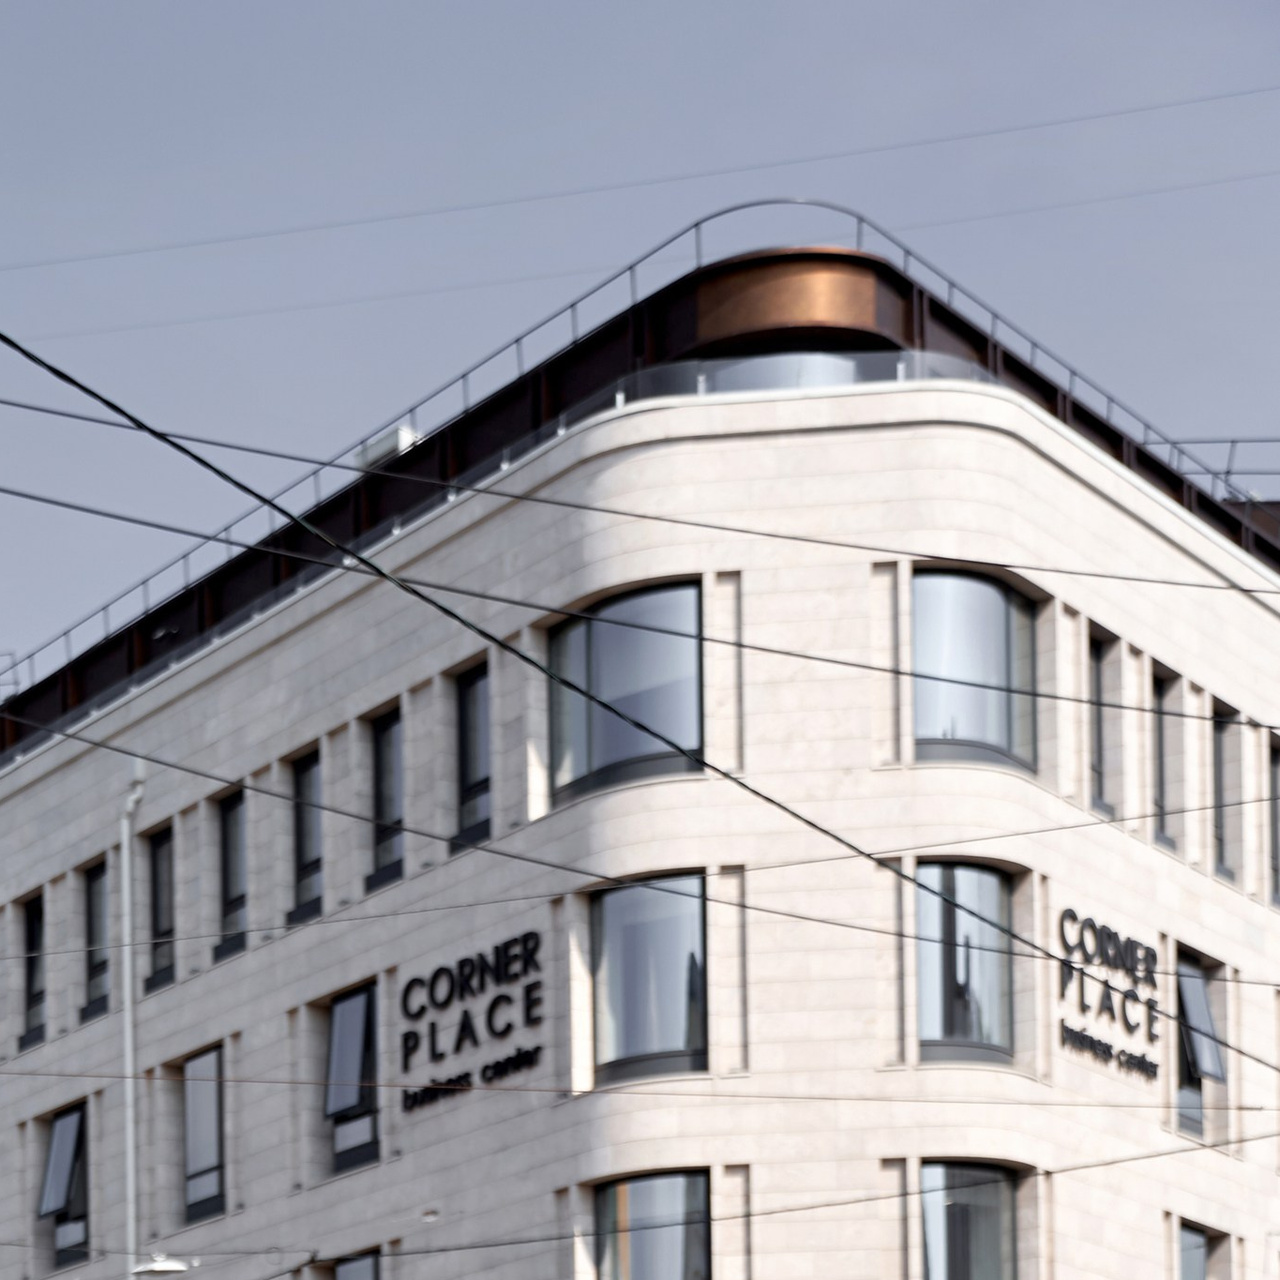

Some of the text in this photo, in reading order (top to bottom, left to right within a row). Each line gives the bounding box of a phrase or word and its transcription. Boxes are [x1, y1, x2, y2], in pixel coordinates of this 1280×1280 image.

[401, 931, 541, 1021] CORNER
[1060, 908, 1158, 990] CORNER
[402, 980, 542, 1074] PLACE
[1059, 958, 1159, 1043] PLACE
